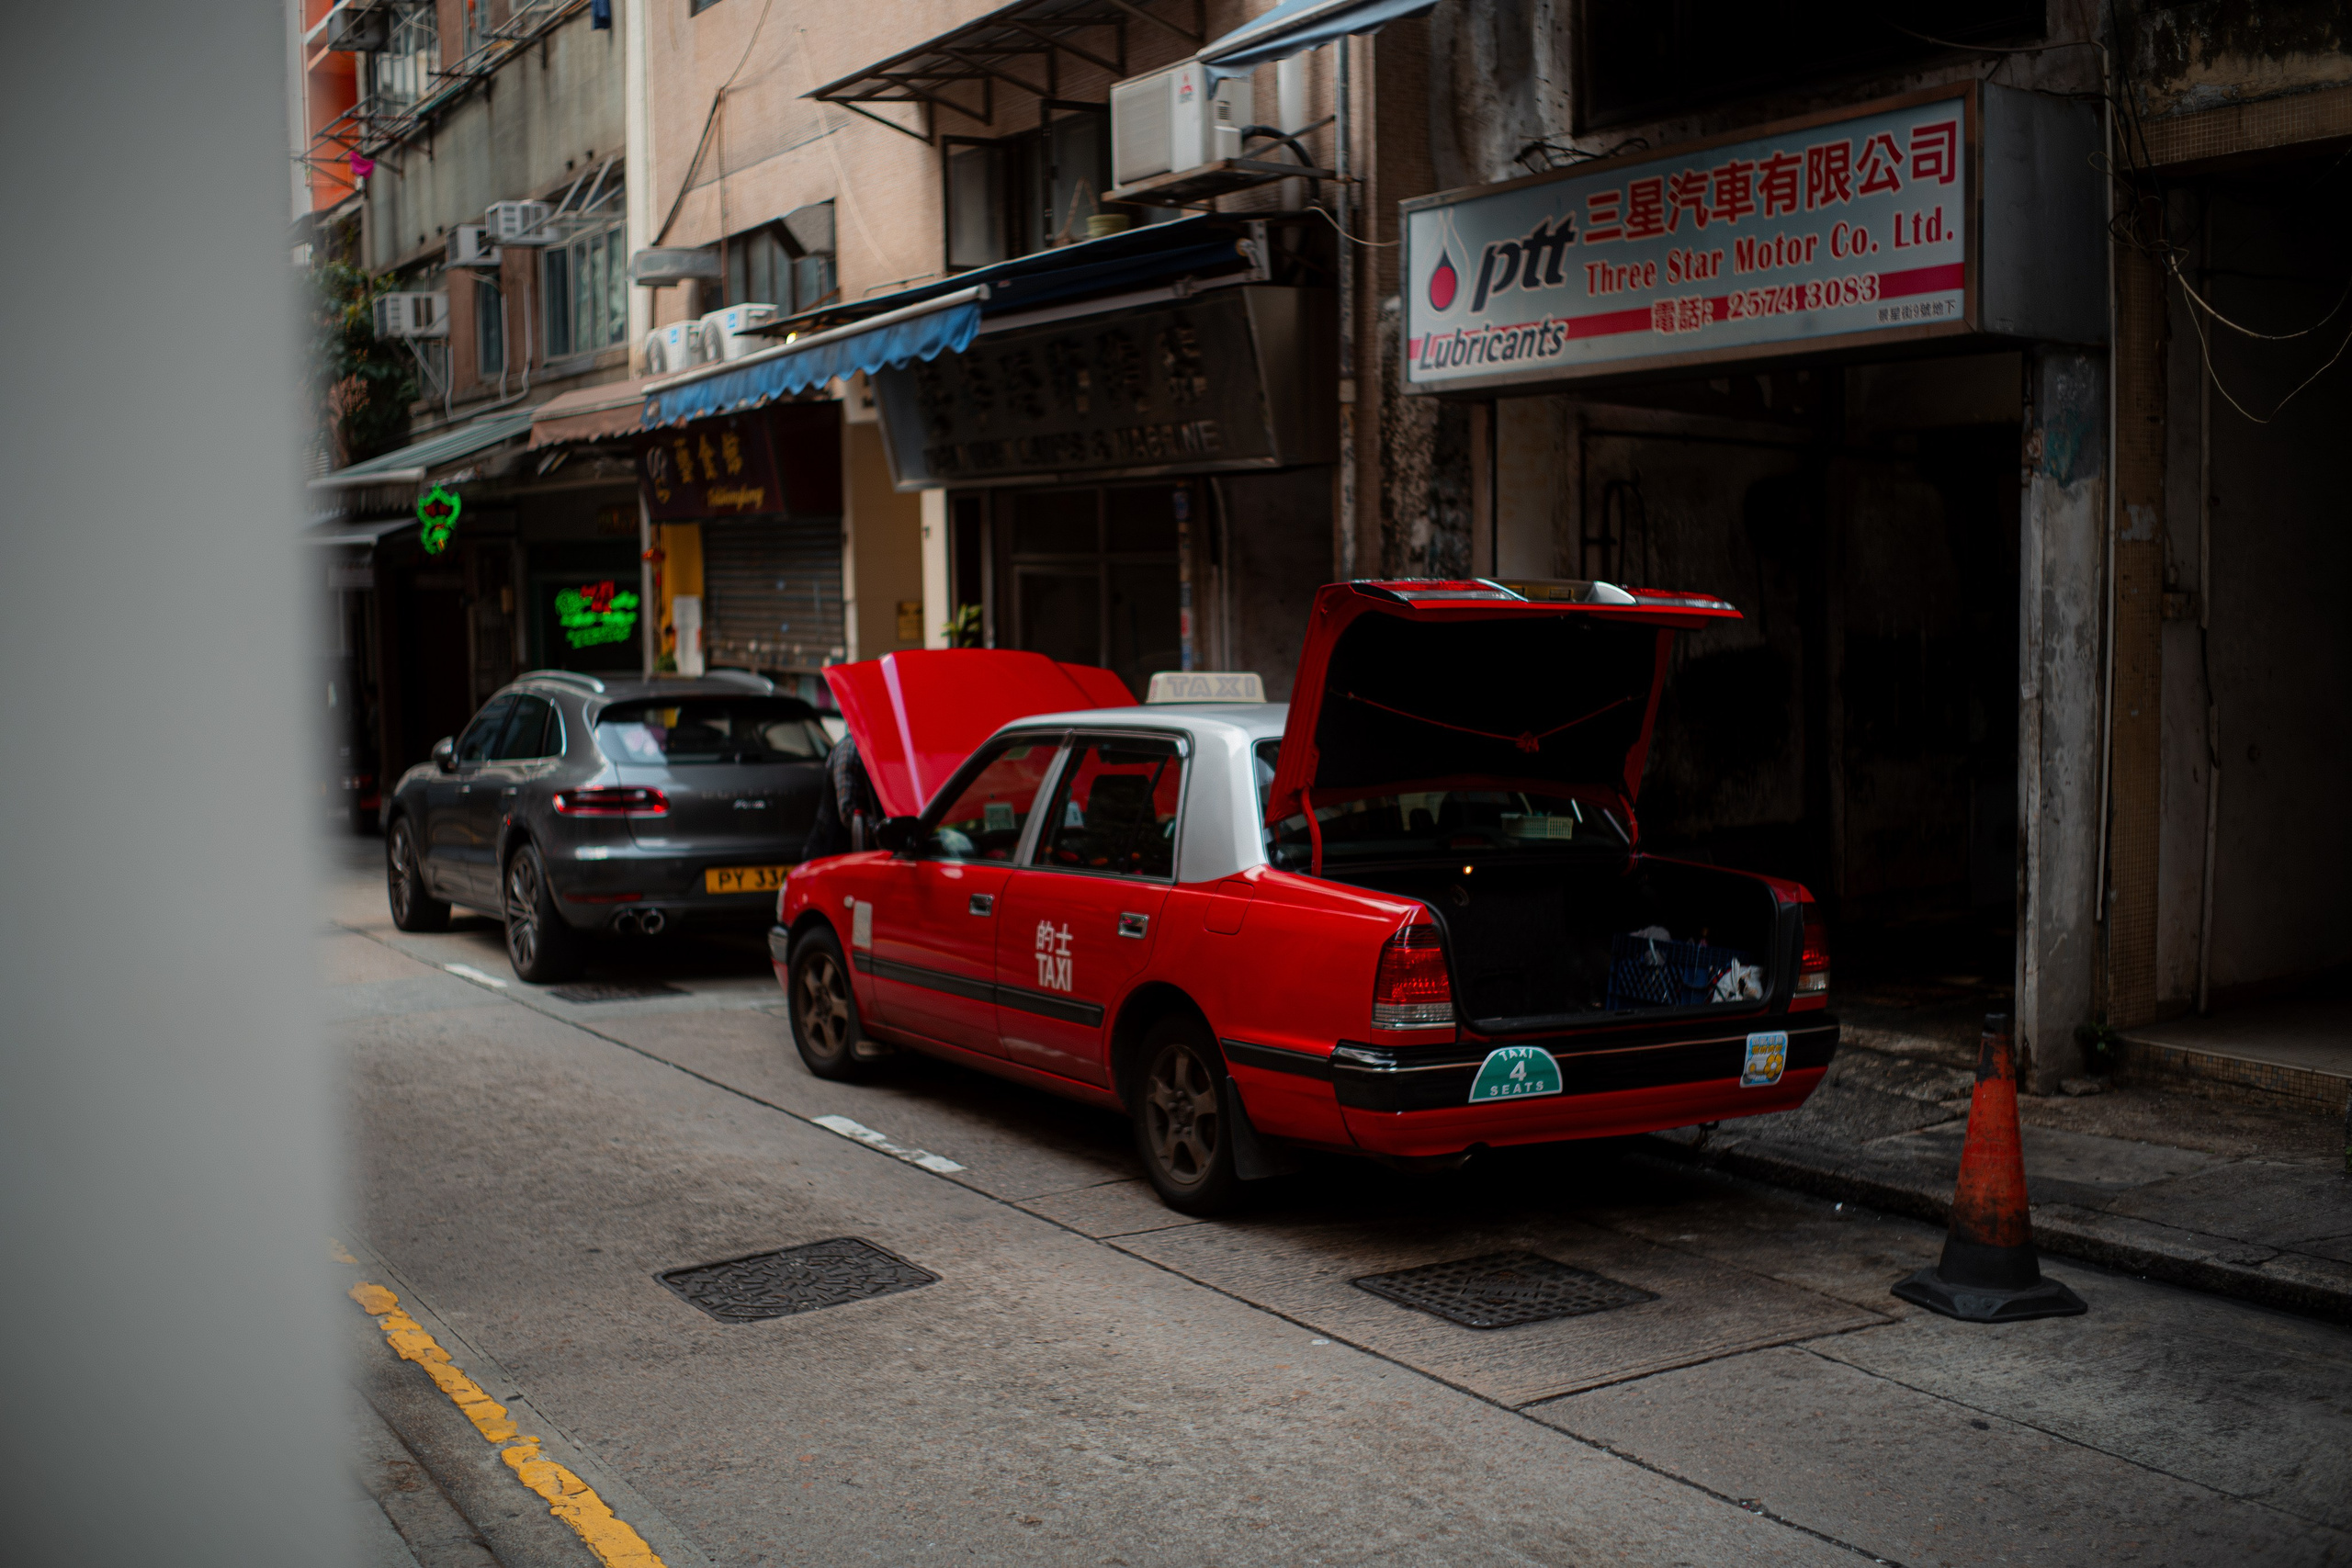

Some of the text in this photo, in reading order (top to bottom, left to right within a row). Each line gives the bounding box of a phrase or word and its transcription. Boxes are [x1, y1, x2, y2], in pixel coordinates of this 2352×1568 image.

[1584, 119, 1958, 244] 三星汽車有限公司
[1470, 212, 1577, 313] ptt
[1585, 206, 1954, 296] Three Star Motor Co. Ltd.
[1727, 283, 1798, 321] 2574
[1804, 273, 1880, 310] 3083
[1419, 316, 1566, 370] Lubricants
[1167, 676, 1256, 697] TAXI
[718, 870, 743, 889] PY
[1035, 919, 1073, 956] 的士
[1035, 952, 1073, 992] TAXI
[1498, 1049, 1533, 1062] TAXI
[1510, 1060, 1527, 1081] 4
[1490, 1080, 1544, 1096] SEATS
